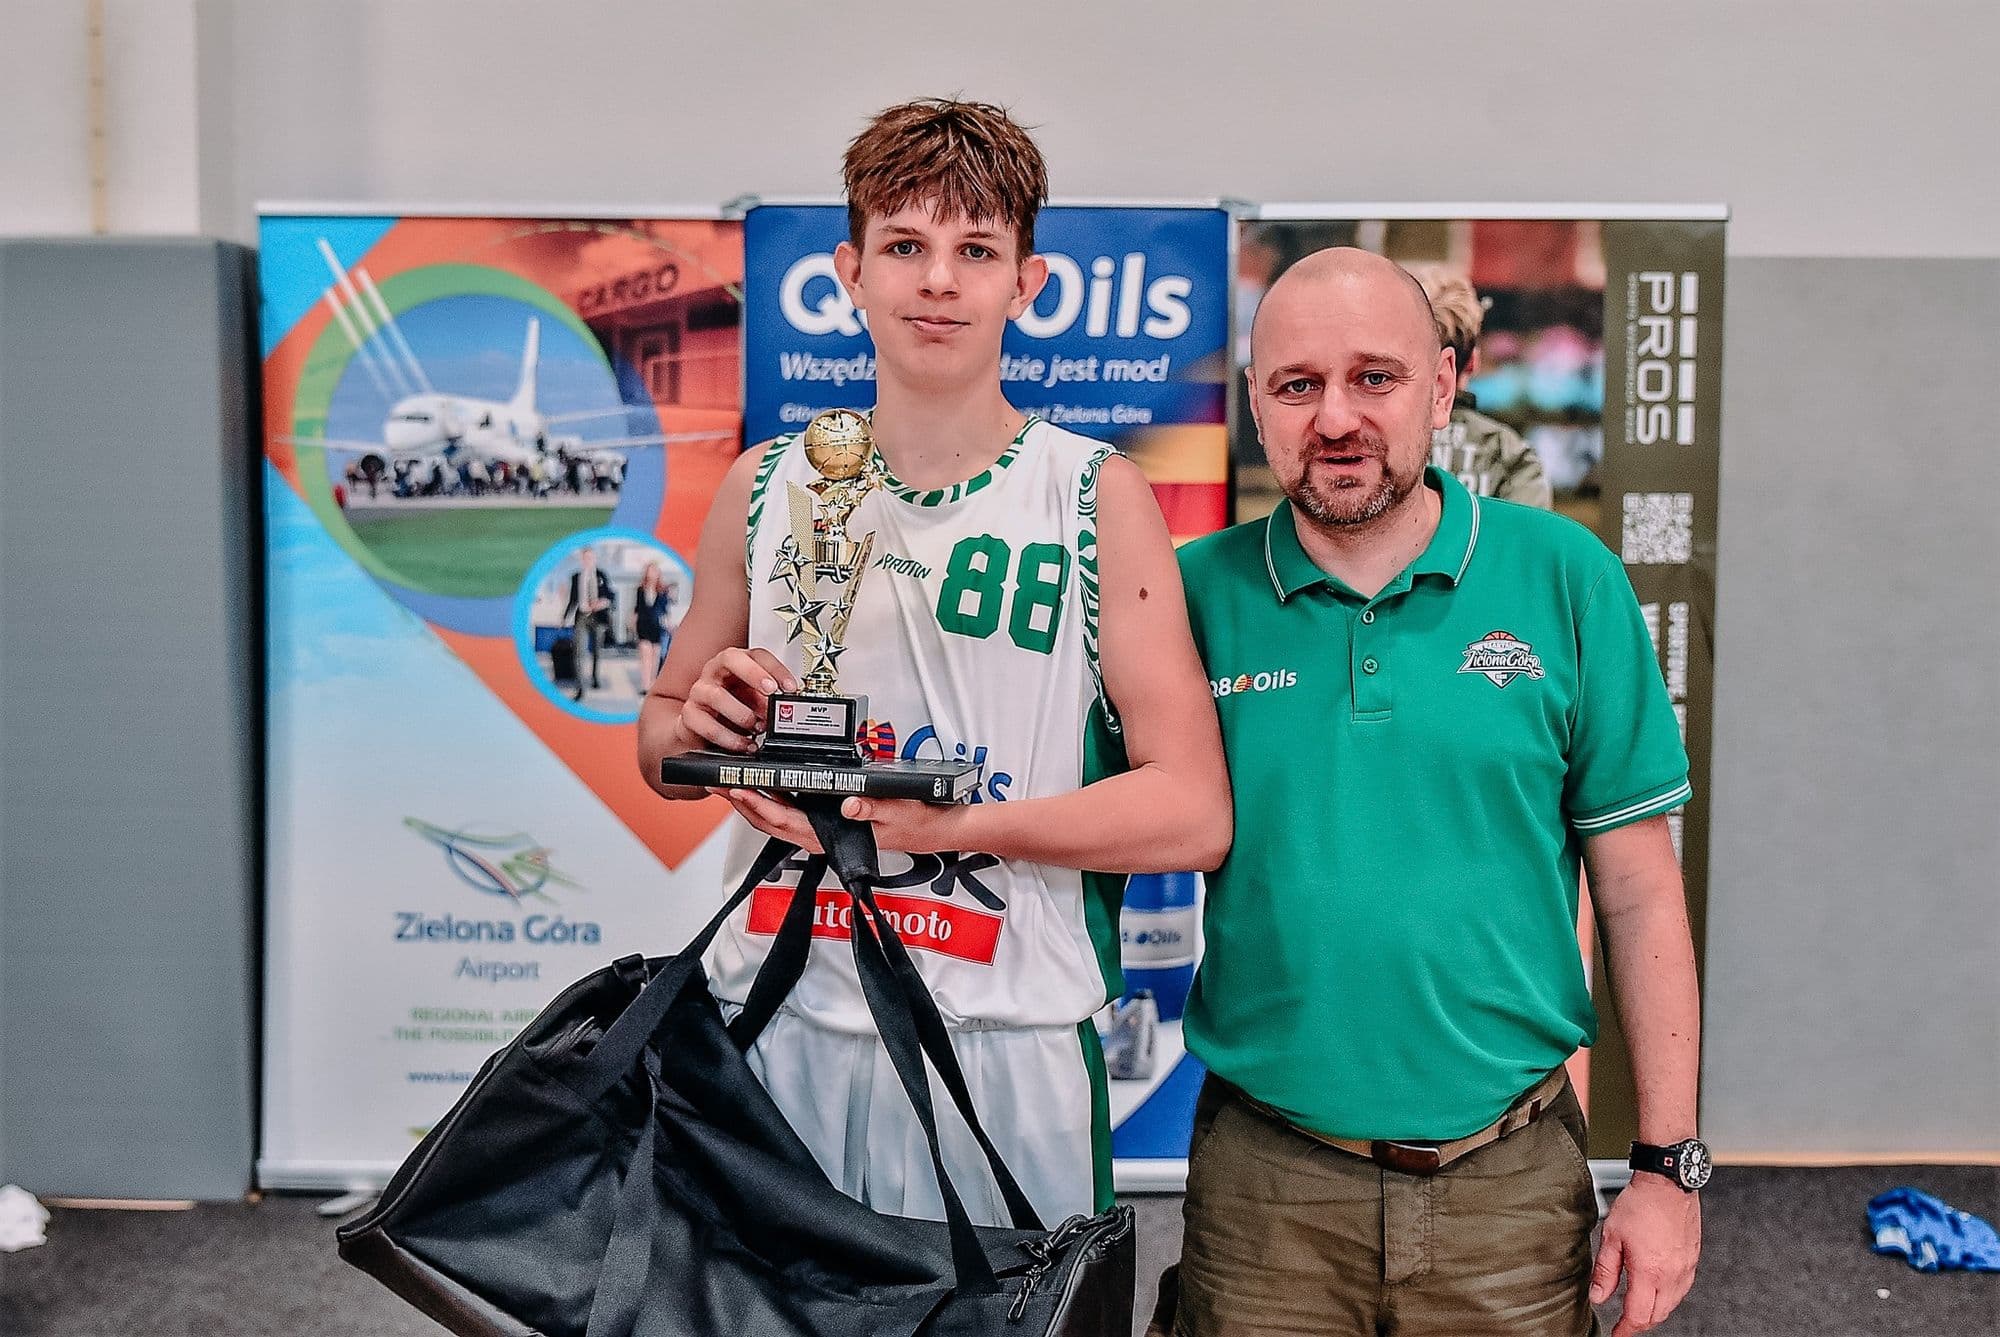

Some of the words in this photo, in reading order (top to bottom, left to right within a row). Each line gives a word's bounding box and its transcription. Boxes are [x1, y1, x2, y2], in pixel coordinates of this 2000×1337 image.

[577, 263, 679, 313] CARGO
[779, 252, 872, 337] Q
[1013, 251, 1194, 340] Oils
[1044, 353, 1098, 388] jest
[1636, 271, 1675, 445] PROS
[935, 533, 1072, 656] 88
[1253, 669, 1298, 692] Oils
[810, 706, 828, 714] MVP
[720, 765, 742, 785] KOBE
[743, 767, 776, 787] BRYANT
[834, 772, 868, 792] MAMBY
[394, 912, 516, 942] Zielona
[522, 911, 602, 945] Góra
[455, 956, 541, 982] Airport
[409, 1007, 494, 1022] REGIONAL
[394, 1026, 422, 1041] THE
